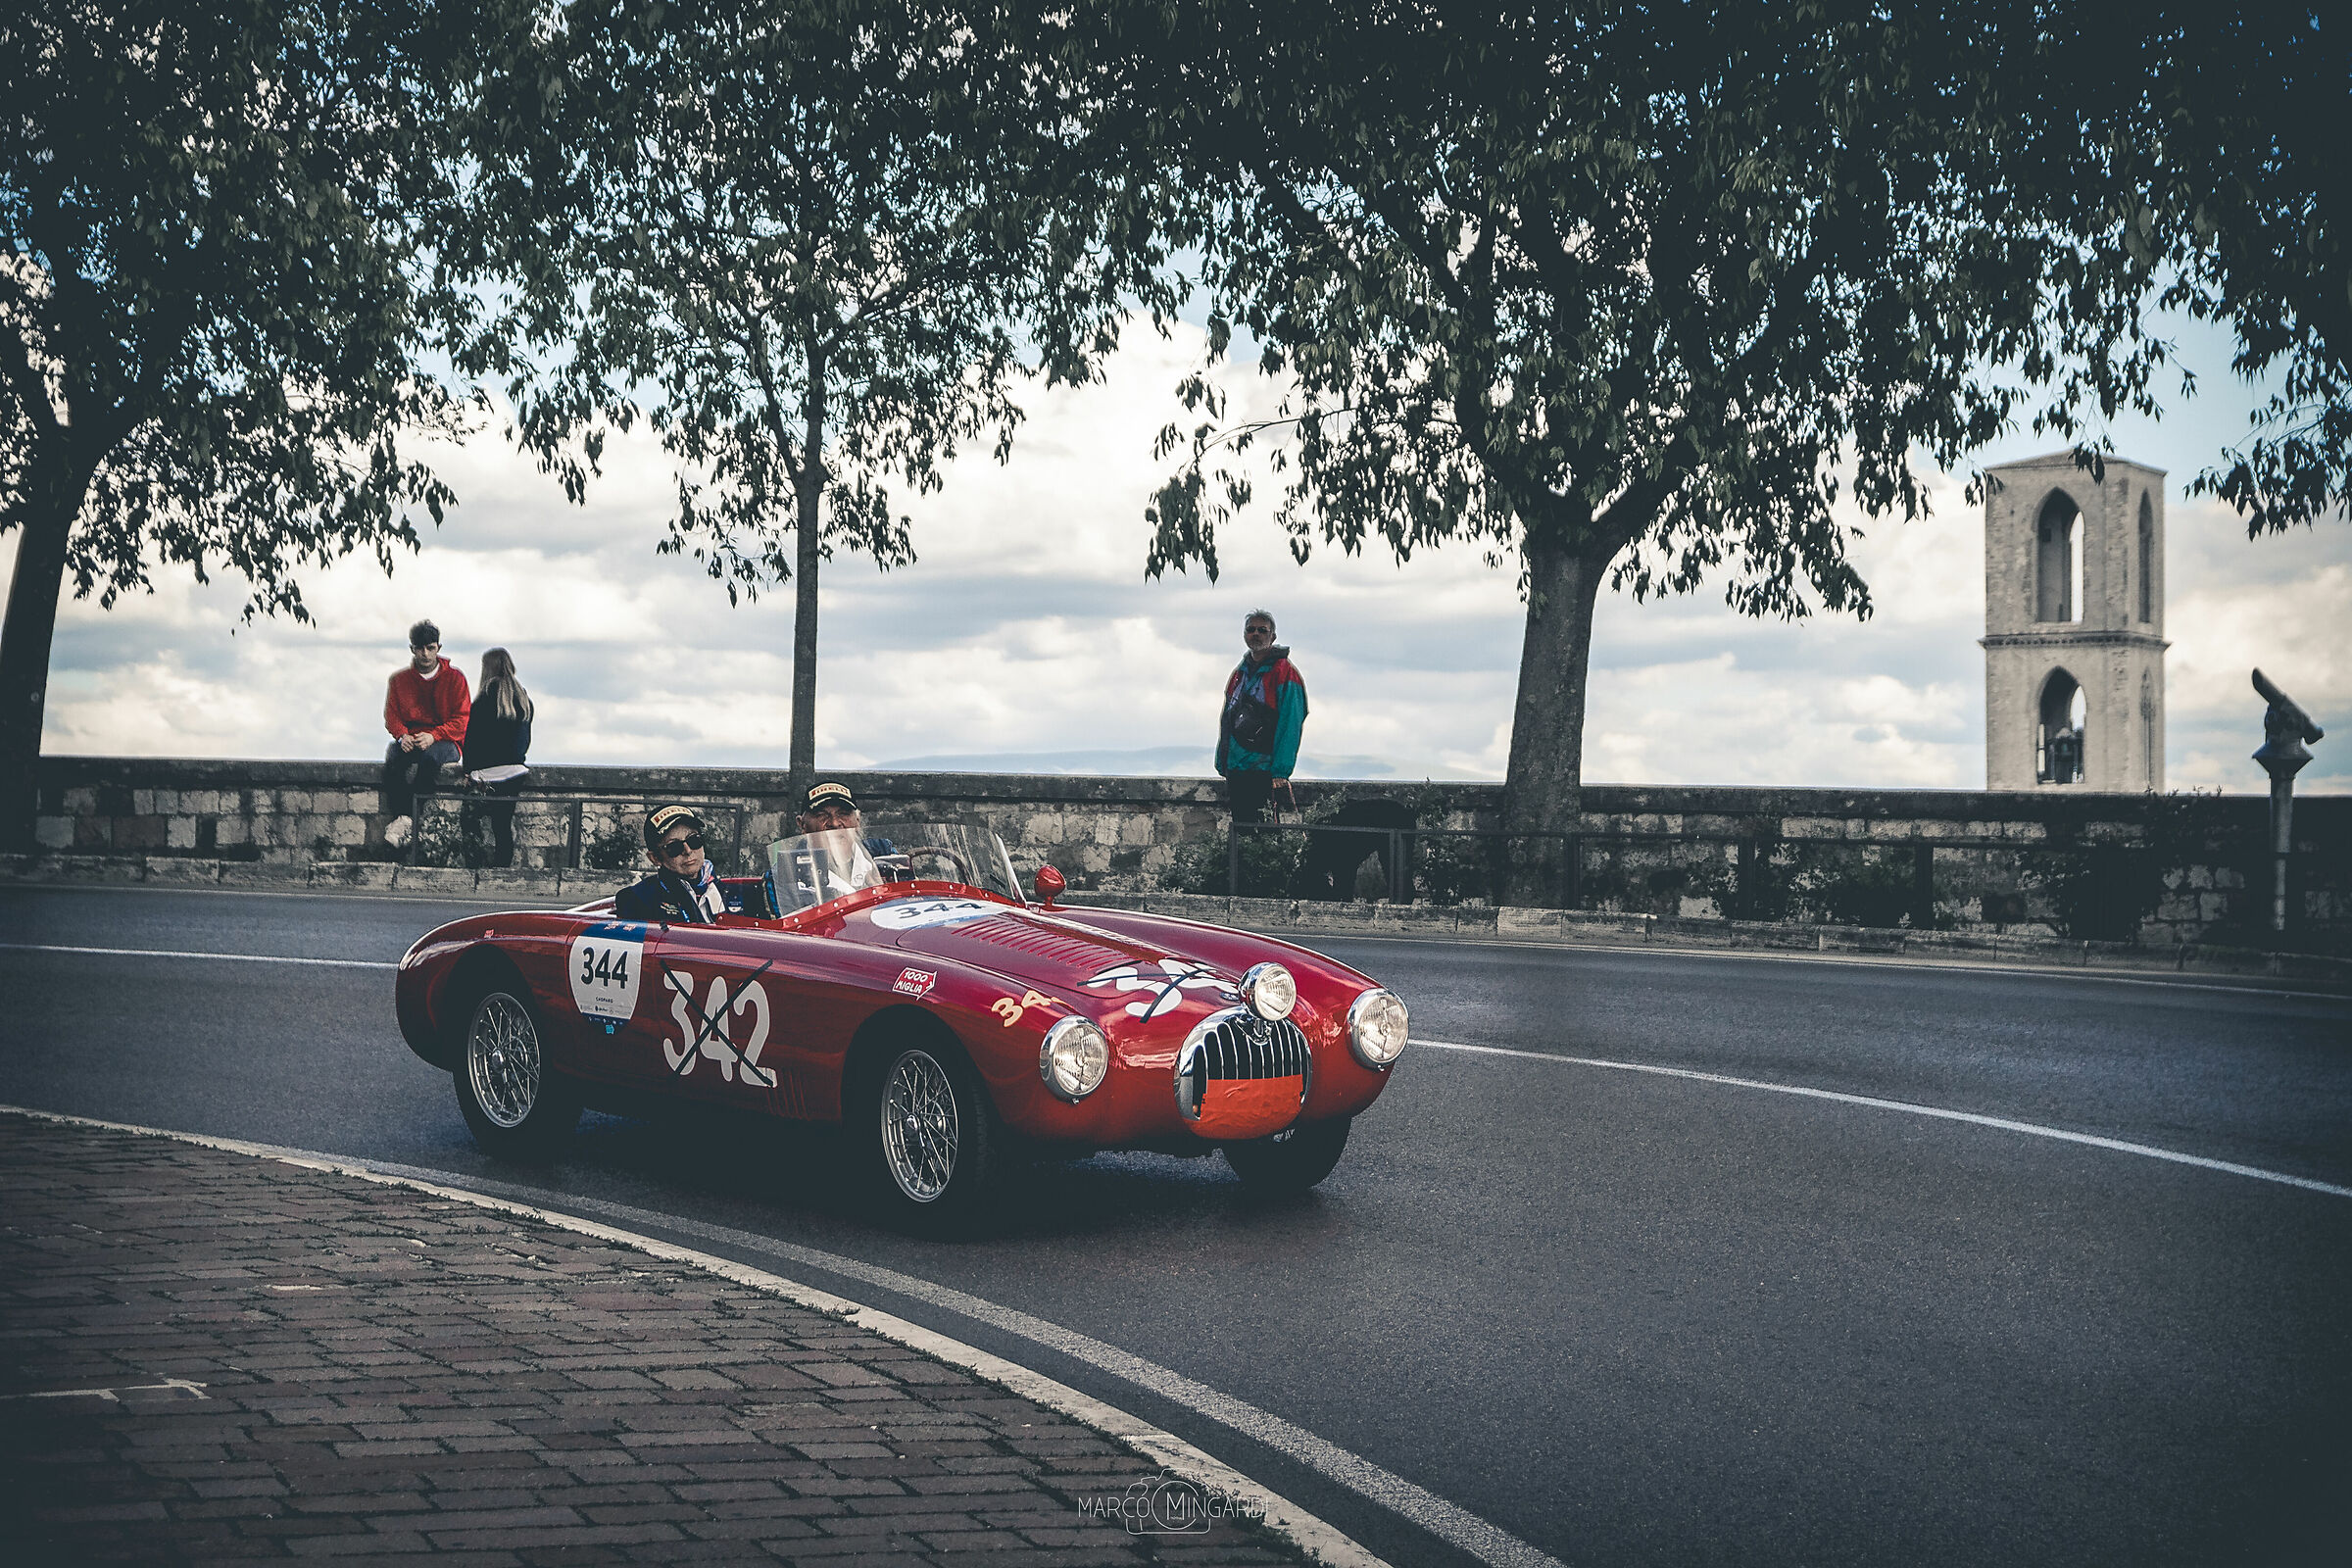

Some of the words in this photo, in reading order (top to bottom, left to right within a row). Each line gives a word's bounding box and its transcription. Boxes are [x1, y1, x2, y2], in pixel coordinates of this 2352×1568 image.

[580, 947, 628, 989] 344
[904, 970, 929, 982] 1000
[896, 981, 922, 994] MIGLIA
[662, 970, 778, 1088] 342
